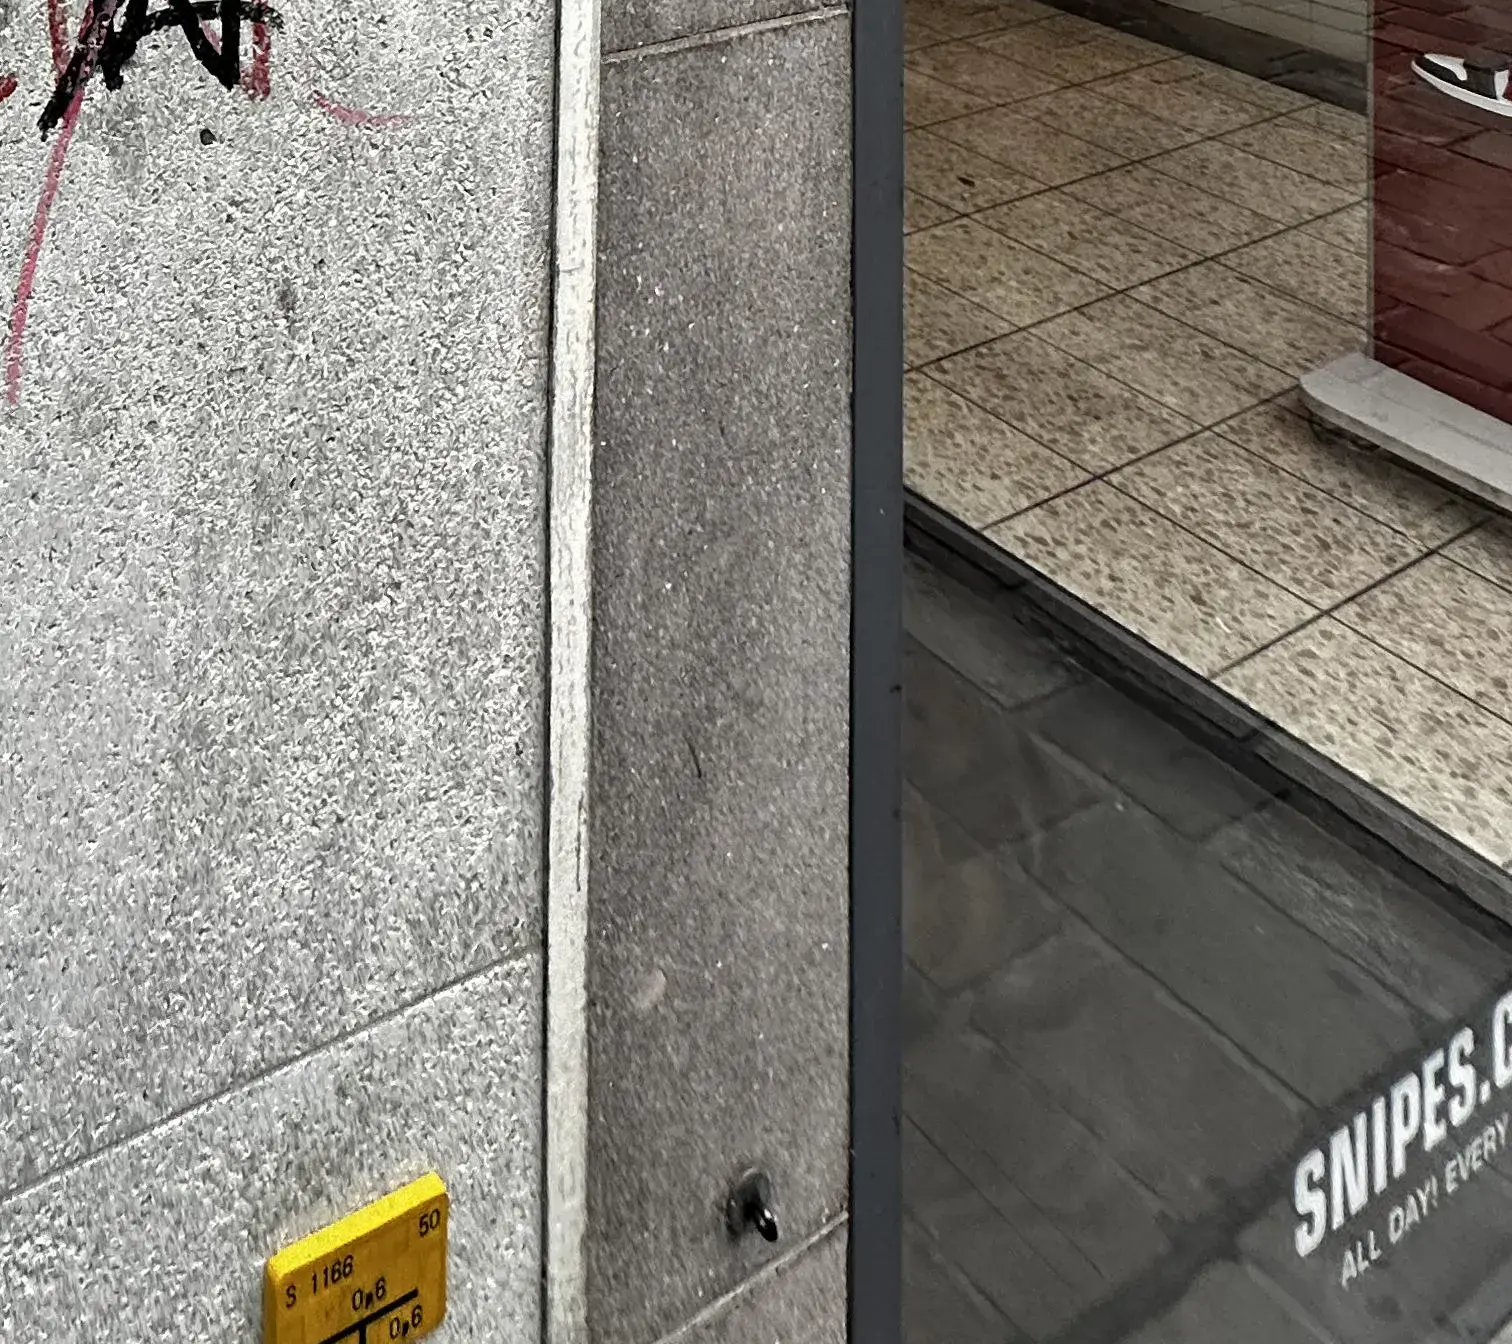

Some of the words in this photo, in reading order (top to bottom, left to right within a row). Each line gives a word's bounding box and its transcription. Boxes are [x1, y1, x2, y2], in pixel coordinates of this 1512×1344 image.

[285, 1284, 297, 1309] S
[419, 1208, 441, 1237] 50
[1341, 1229, 1382, 1291] ALL
[1388, 1175, 1438, 1244] DAY!
[1444, 1113, 1510, 1194] EVERY
